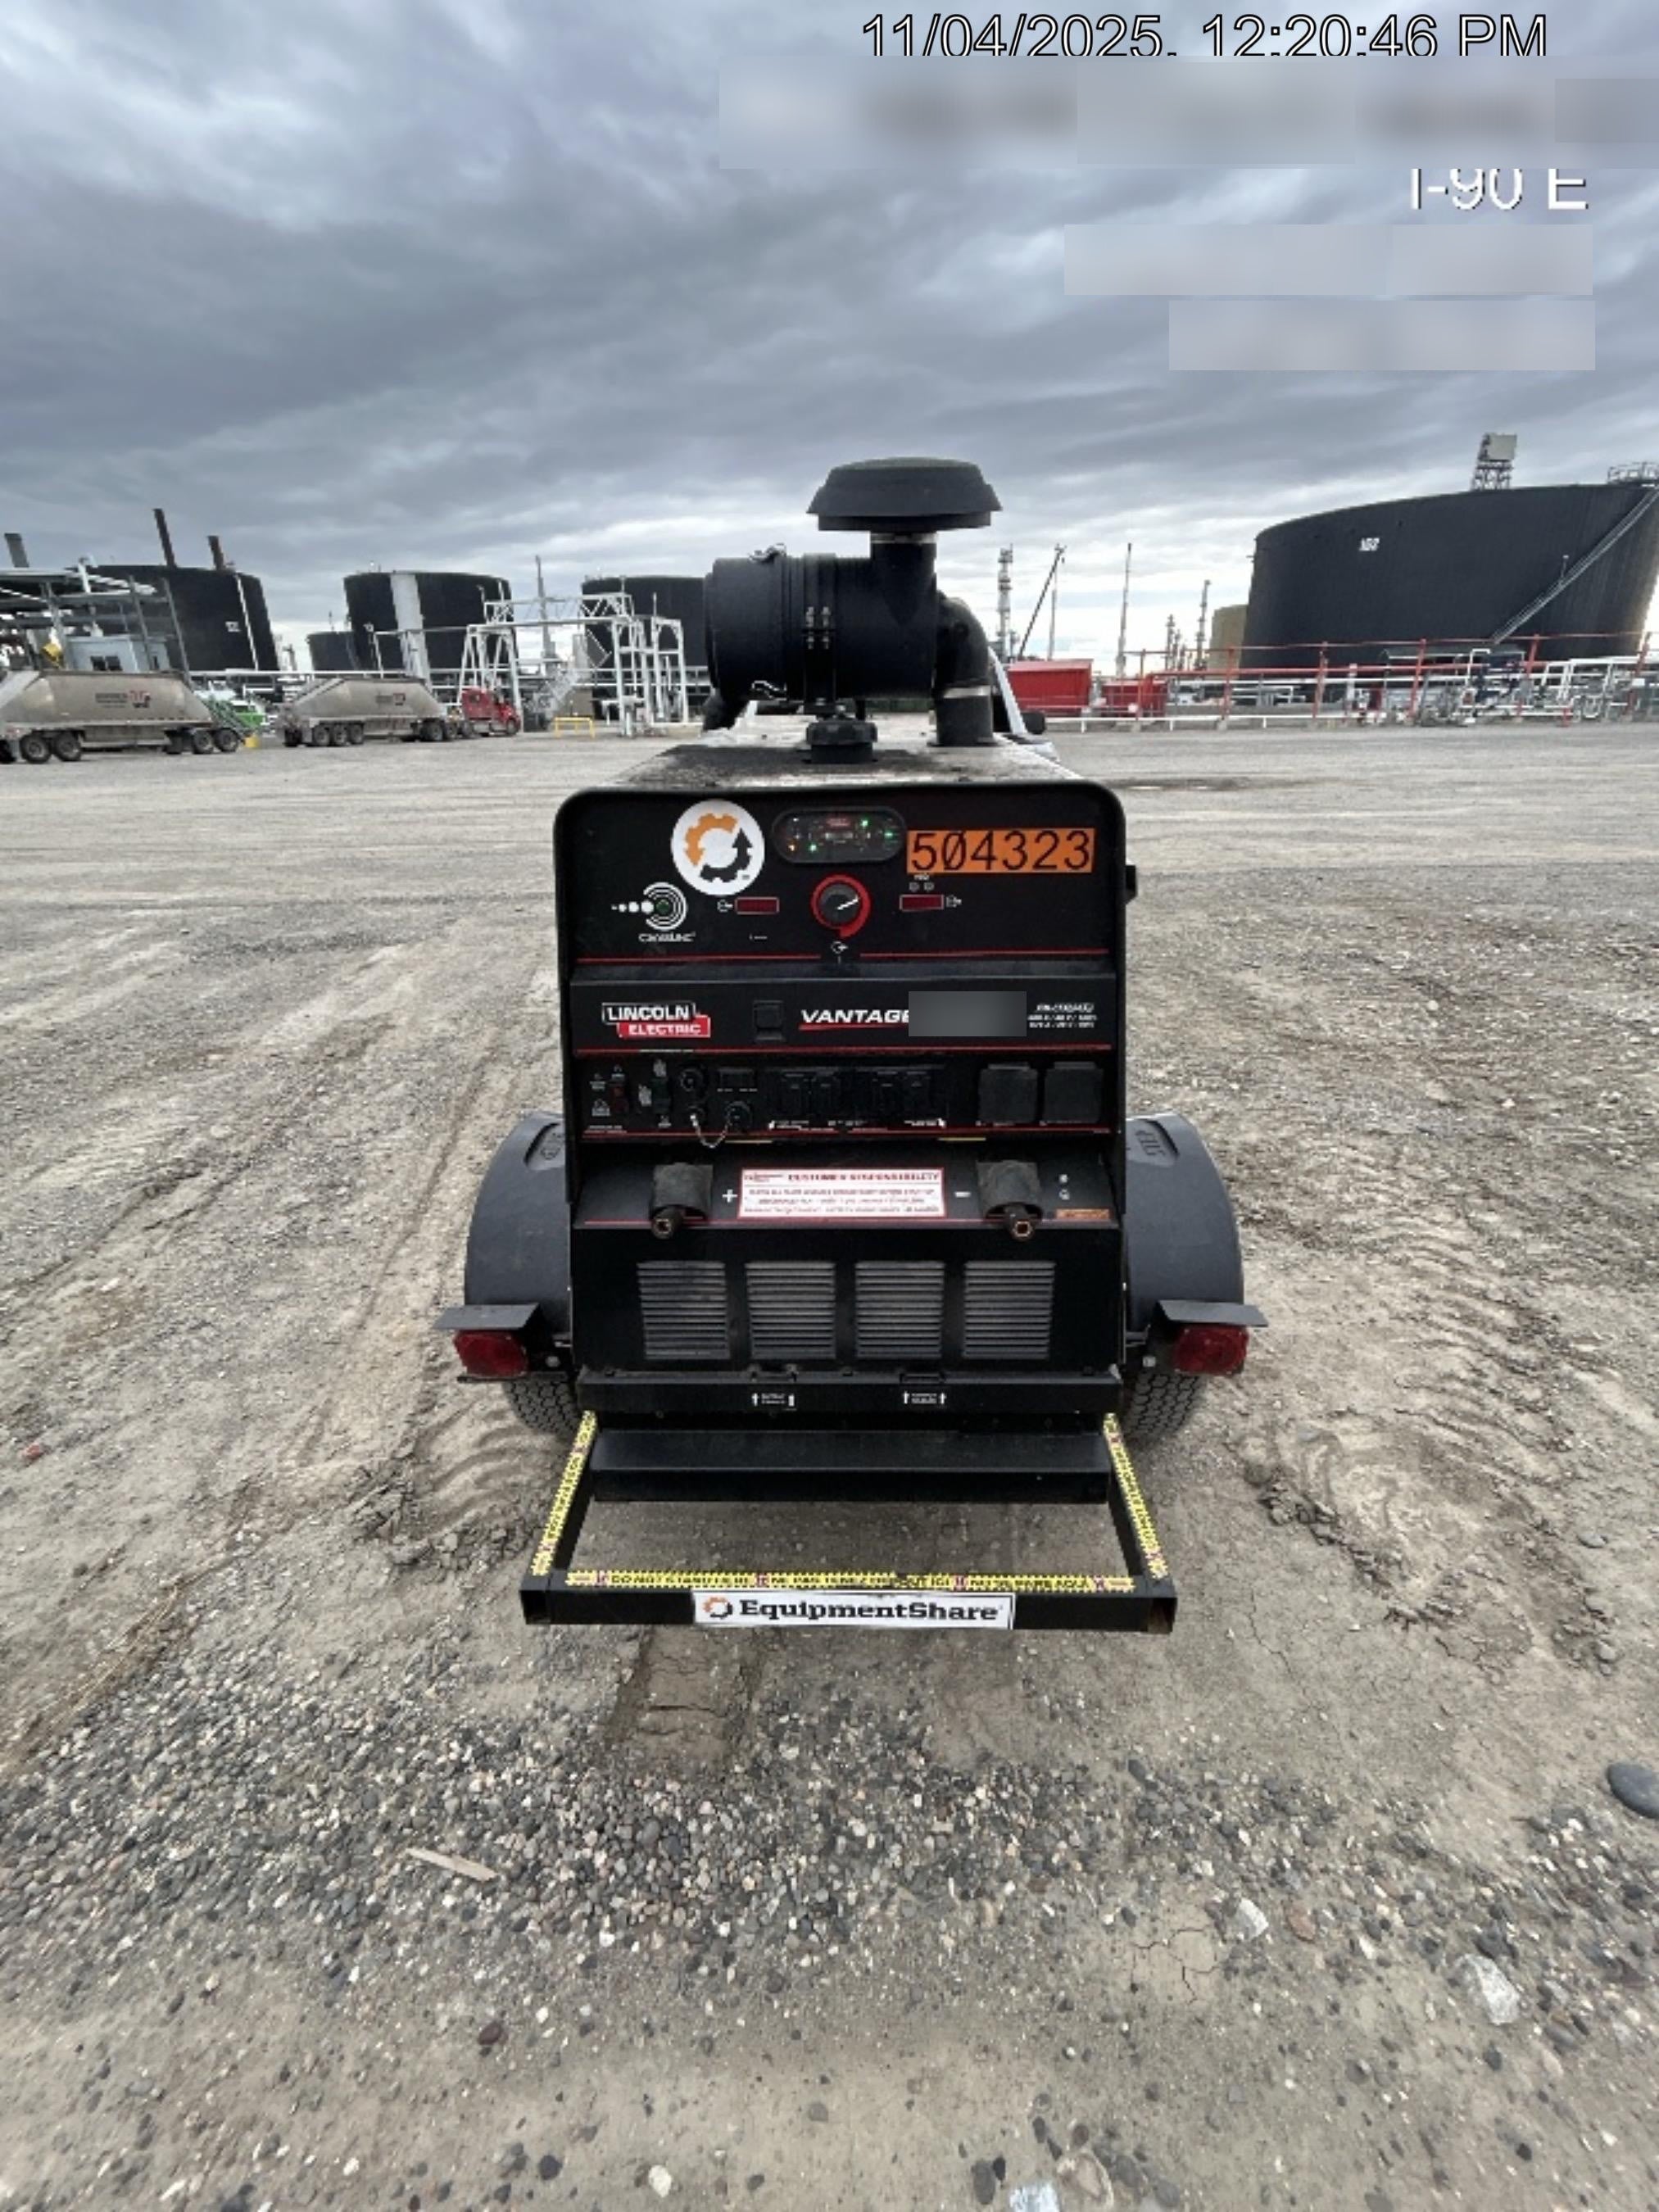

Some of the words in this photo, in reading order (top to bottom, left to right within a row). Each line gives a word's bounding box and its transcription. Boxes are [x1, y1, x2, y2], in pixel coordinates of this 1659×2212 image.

[911, 830, 1090, 871] 504323
[606, 1005, 689, 1021] LINCOLN
[628, 1023, 702, 1036] ELECTRIC
[739, 1598, 999, 1621] EquipmentShare
